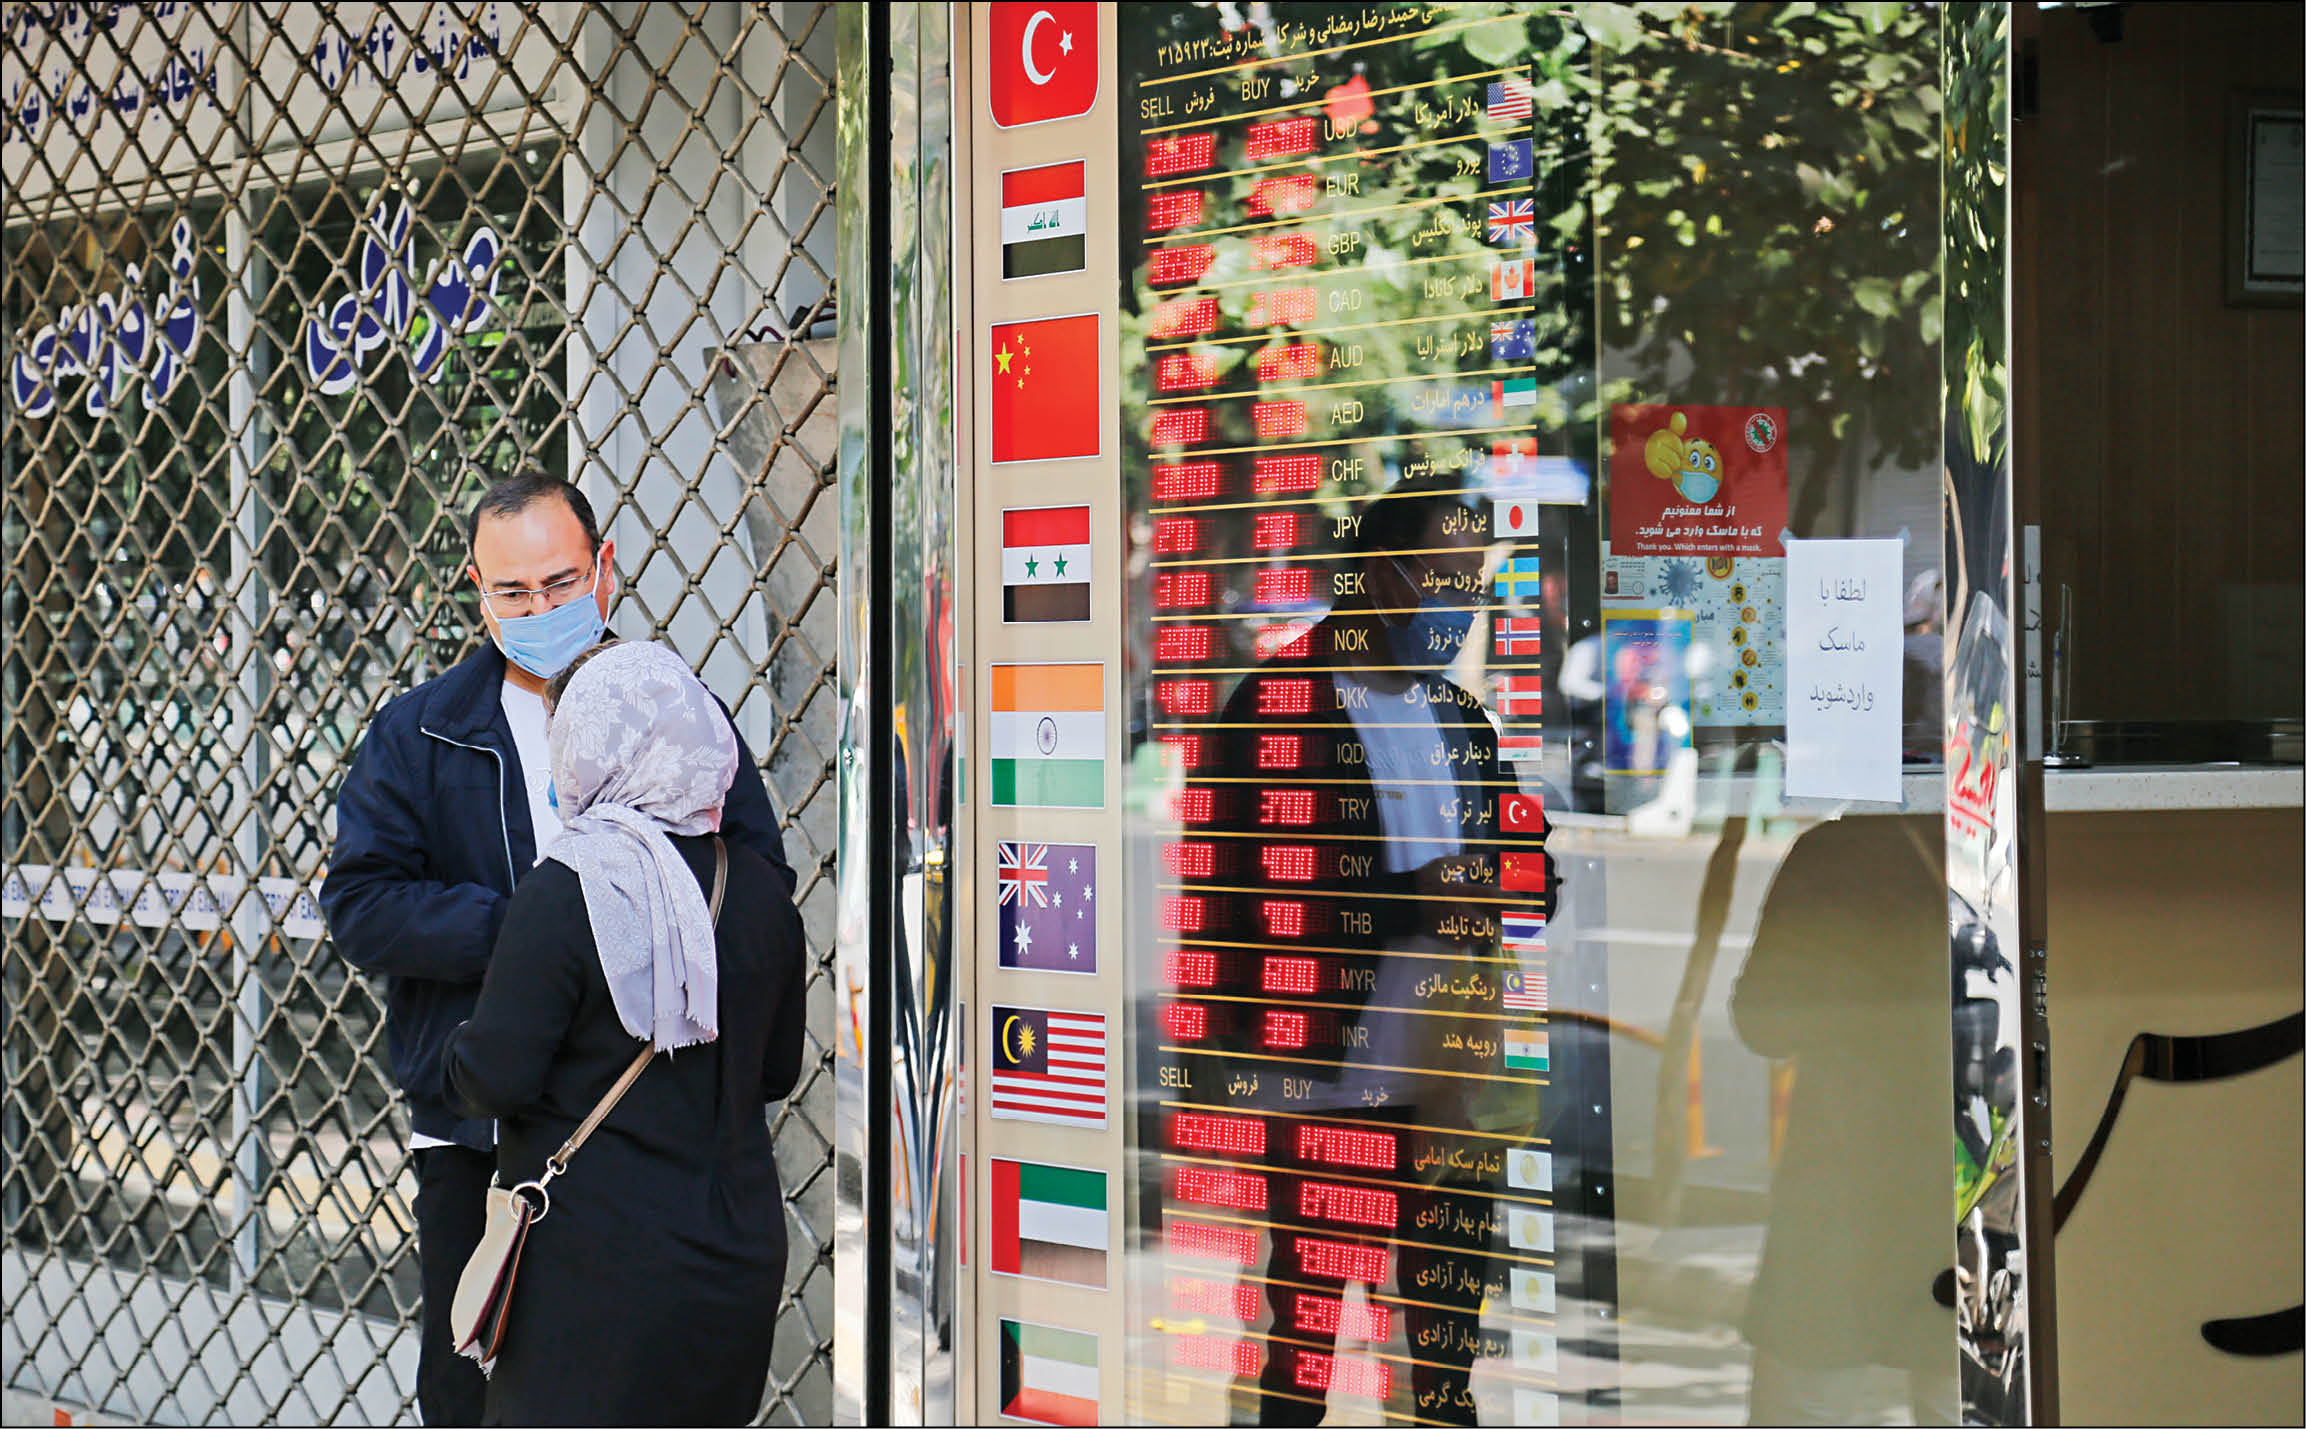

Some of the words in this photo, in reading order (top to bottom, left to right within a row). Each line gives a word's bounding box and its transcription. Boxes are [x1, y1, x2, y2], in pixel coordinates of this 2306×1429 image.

[1318, 15, 1360, 43] رمضانی
[1363, 9, 1385, 31] رضا
[1388, 8, 1418, 27] حمید
[1309, 28, 1316, 45] و
[1242, 77, 1270, 101] BUY
[1295, 69, 1320, 93] خرید
[1141, 96, 1174, 119] SELL
[1185, 87, 1215, 113] فروش
[1415, 95, 1453, 129] آمریکا
[1456, 96, 1479, 123] دلار
[1325, 117, 1357, 141] USD
[1457, 157, 1481, 176] یورو
[1326, 173, 1360, 198] EUR
[1328, 231, 1360, 255] GBP
[1424, 275, 1457, 299] کانادا
[1460, 273, 1483, 300] دلار
[1329, 289, 1362, 312] CAD
[1417, 333, 1457, 361] استرالیا
[1460, 331, 1484, 357] دلار
[1330, 345, 1364, 369] AUD
[1331, 401, 1364, 426] AED
[1332, 458, 1364, 482] CHF
[1404, 451, 1450, 479] سوئیس
[1442, 507, 1468, 536] ژاپن
[1661, 505, 1702, 520] ممنونیم
[1704, 504, 1724, 516] شما
[1725, 506, 1736, 518] از
[1333, 515, 1362, 539] JPY
[1471, 514, 1487, 533] ین
[1666, 527, 1681, 538] می
[1683, 526, 1704, 537] وارد
[1706, 525, 1738, 537] ماسک
[1741, 525, 1749, 539] با
[1751, 525, 1763, 537] که
[1636, 543, 1657, 551] Thank
[1674, 543, 1696, 551] Which
[1333, 572, 1366, 596] SEK
[1422, 568, 1451, 594] سوئد
[1820, 578, 1830, 607] با
[1334, 629, 1369, 651] NOK
[1427, 627, 1452, 651] نروژ
[1819, 624, 1866, 652] ماسک
[1335, 686, 1369, 710] DKK
[1404, 683, 1454, 709] دانمارک
[1336, 743, 1365, 766] IQD
[1431, 741, 1459, 766] عراق
[1462, 742, 1492, 766] دینار
[1338, 798, 1370, 821] TRY
[1440, 798, 1473, 825] ترکیه
[1476, 799, 1493, 825] لیر
[1339, 855, 1373, 878] CNY
[1441, 863, 1466, 883] چین
[1469, 857, 1494, 884] یوان
[1340, 911, 1373, 935] THB
[1437, 915, 1470, 940] تایلند
[1471, 917, 1495, 944] بات
[1340, 967, 1376, 992] MYR
[1415, 973, 1449, 998] مالزی
[1450, 973, 1496, 1001] رینگیت
[1266, 1011, 1305, 1048] 350
[1341, 1025, 1369, 1049] INR
[1442, 1032, 1464, 1050] هند
[1466, 1034, 1497, 1059] روپیه
[1159, 1066, 1193, 1089] SELL
[1228, 1073, 1259, 1096] فروش
[1283, 1078, 1313, 1099] BUY
[1361, 1086, 1390, 1108] خرید
[1414, 1145, 1446, 1172] امامی
[1448, 1148, 1474, 1169] سکه
[1476, 1151, 1500, 1182] تمام
[1416, 1202, 1451, 1231] آزادی
[1453, 1208, 1475, 1236] بهار
[1478, 1211, 1501, 1242] تمام
[1416, 1261, 1455, 1289] آزادی
[1457, 1267, 1480, 1296] بهار
[1418, 1321, 1454, 1349] آزادی
[1457, 1327, 1481, 1356] بهار
[1419, 1379, 1451, 1408] گرمی
